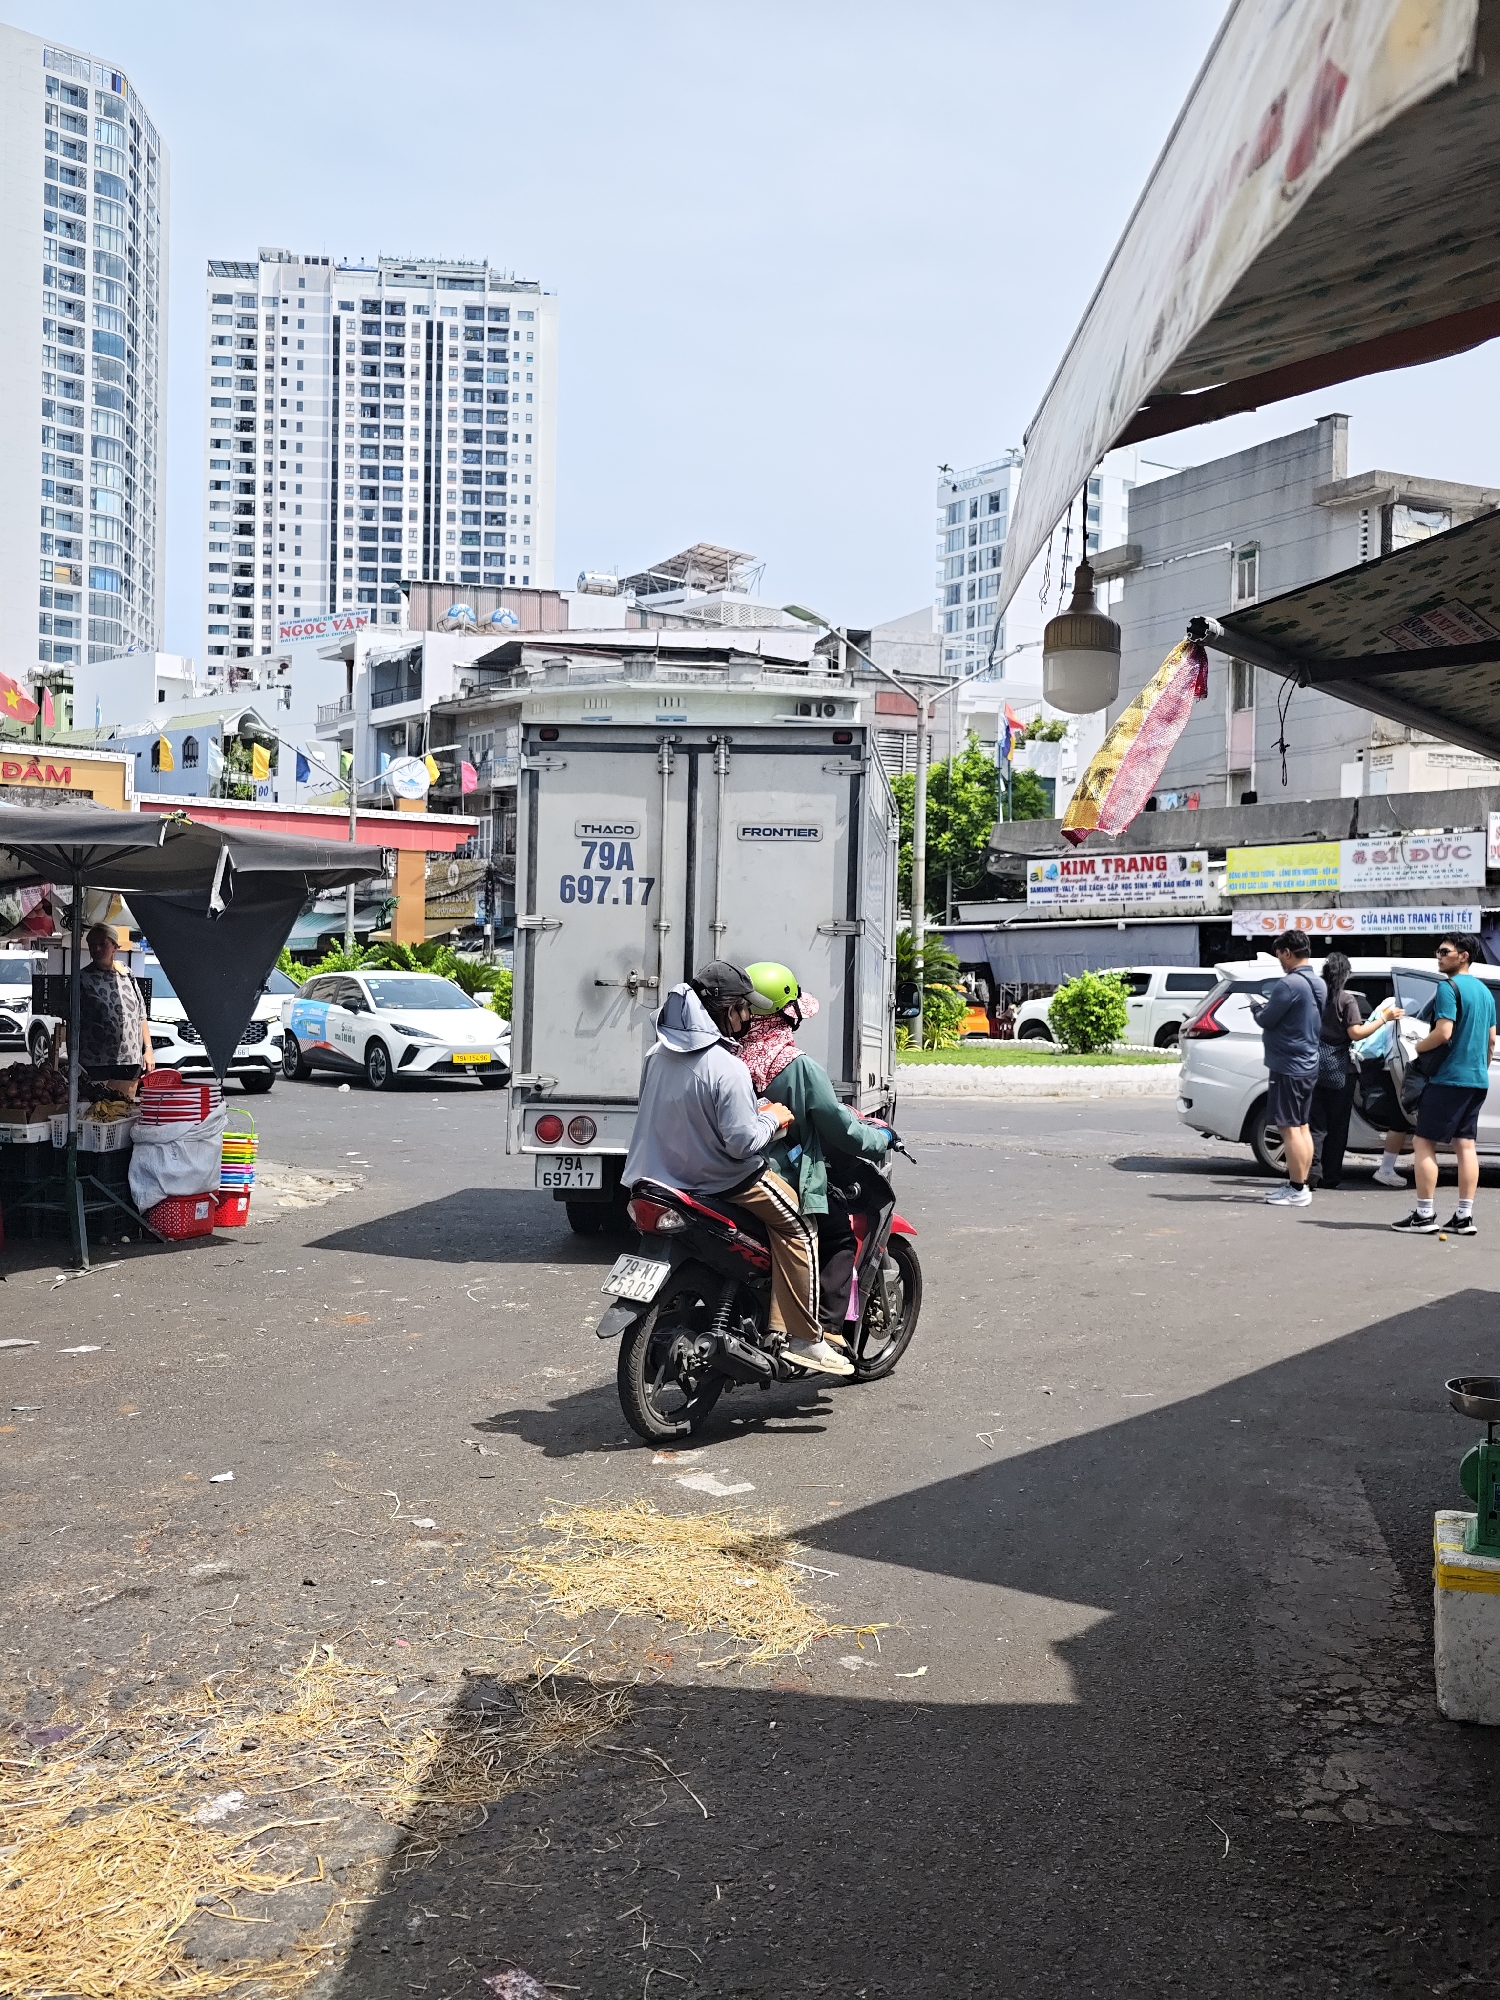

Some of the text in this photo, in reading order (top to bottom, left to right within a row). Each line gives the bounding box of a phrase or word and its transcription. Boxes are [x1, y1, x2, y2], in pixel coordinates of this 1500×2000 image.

[957, 477, 984, 492] ARECA
[279, 616, 369, 639] NGỌC VÂN
[2, 755, 72, 784] ĐẦM
[581, 824, 635, 835] THACO
[741, 827, 819, 838] FRONTIER
[581, 841, 635, 871] 79A
[1408, 842, 1473, 863] ĐỨC
[1060, 855, 1168, 876] KIM TRANG
[559, 874, 656, 906] 697.17
[1030, 885, 1059, 894] SAMSONITE
[1134, 882, 1148, 890] SINH
[1361, 908, 1473, 924] CỬA HÀNG TRANG TRÍ TẾT
[555, 1156, 583, 1171] 79A
[542, 1172, 595, 1188] 697.17
[619, 1258, 660, 1281] 79-N1
